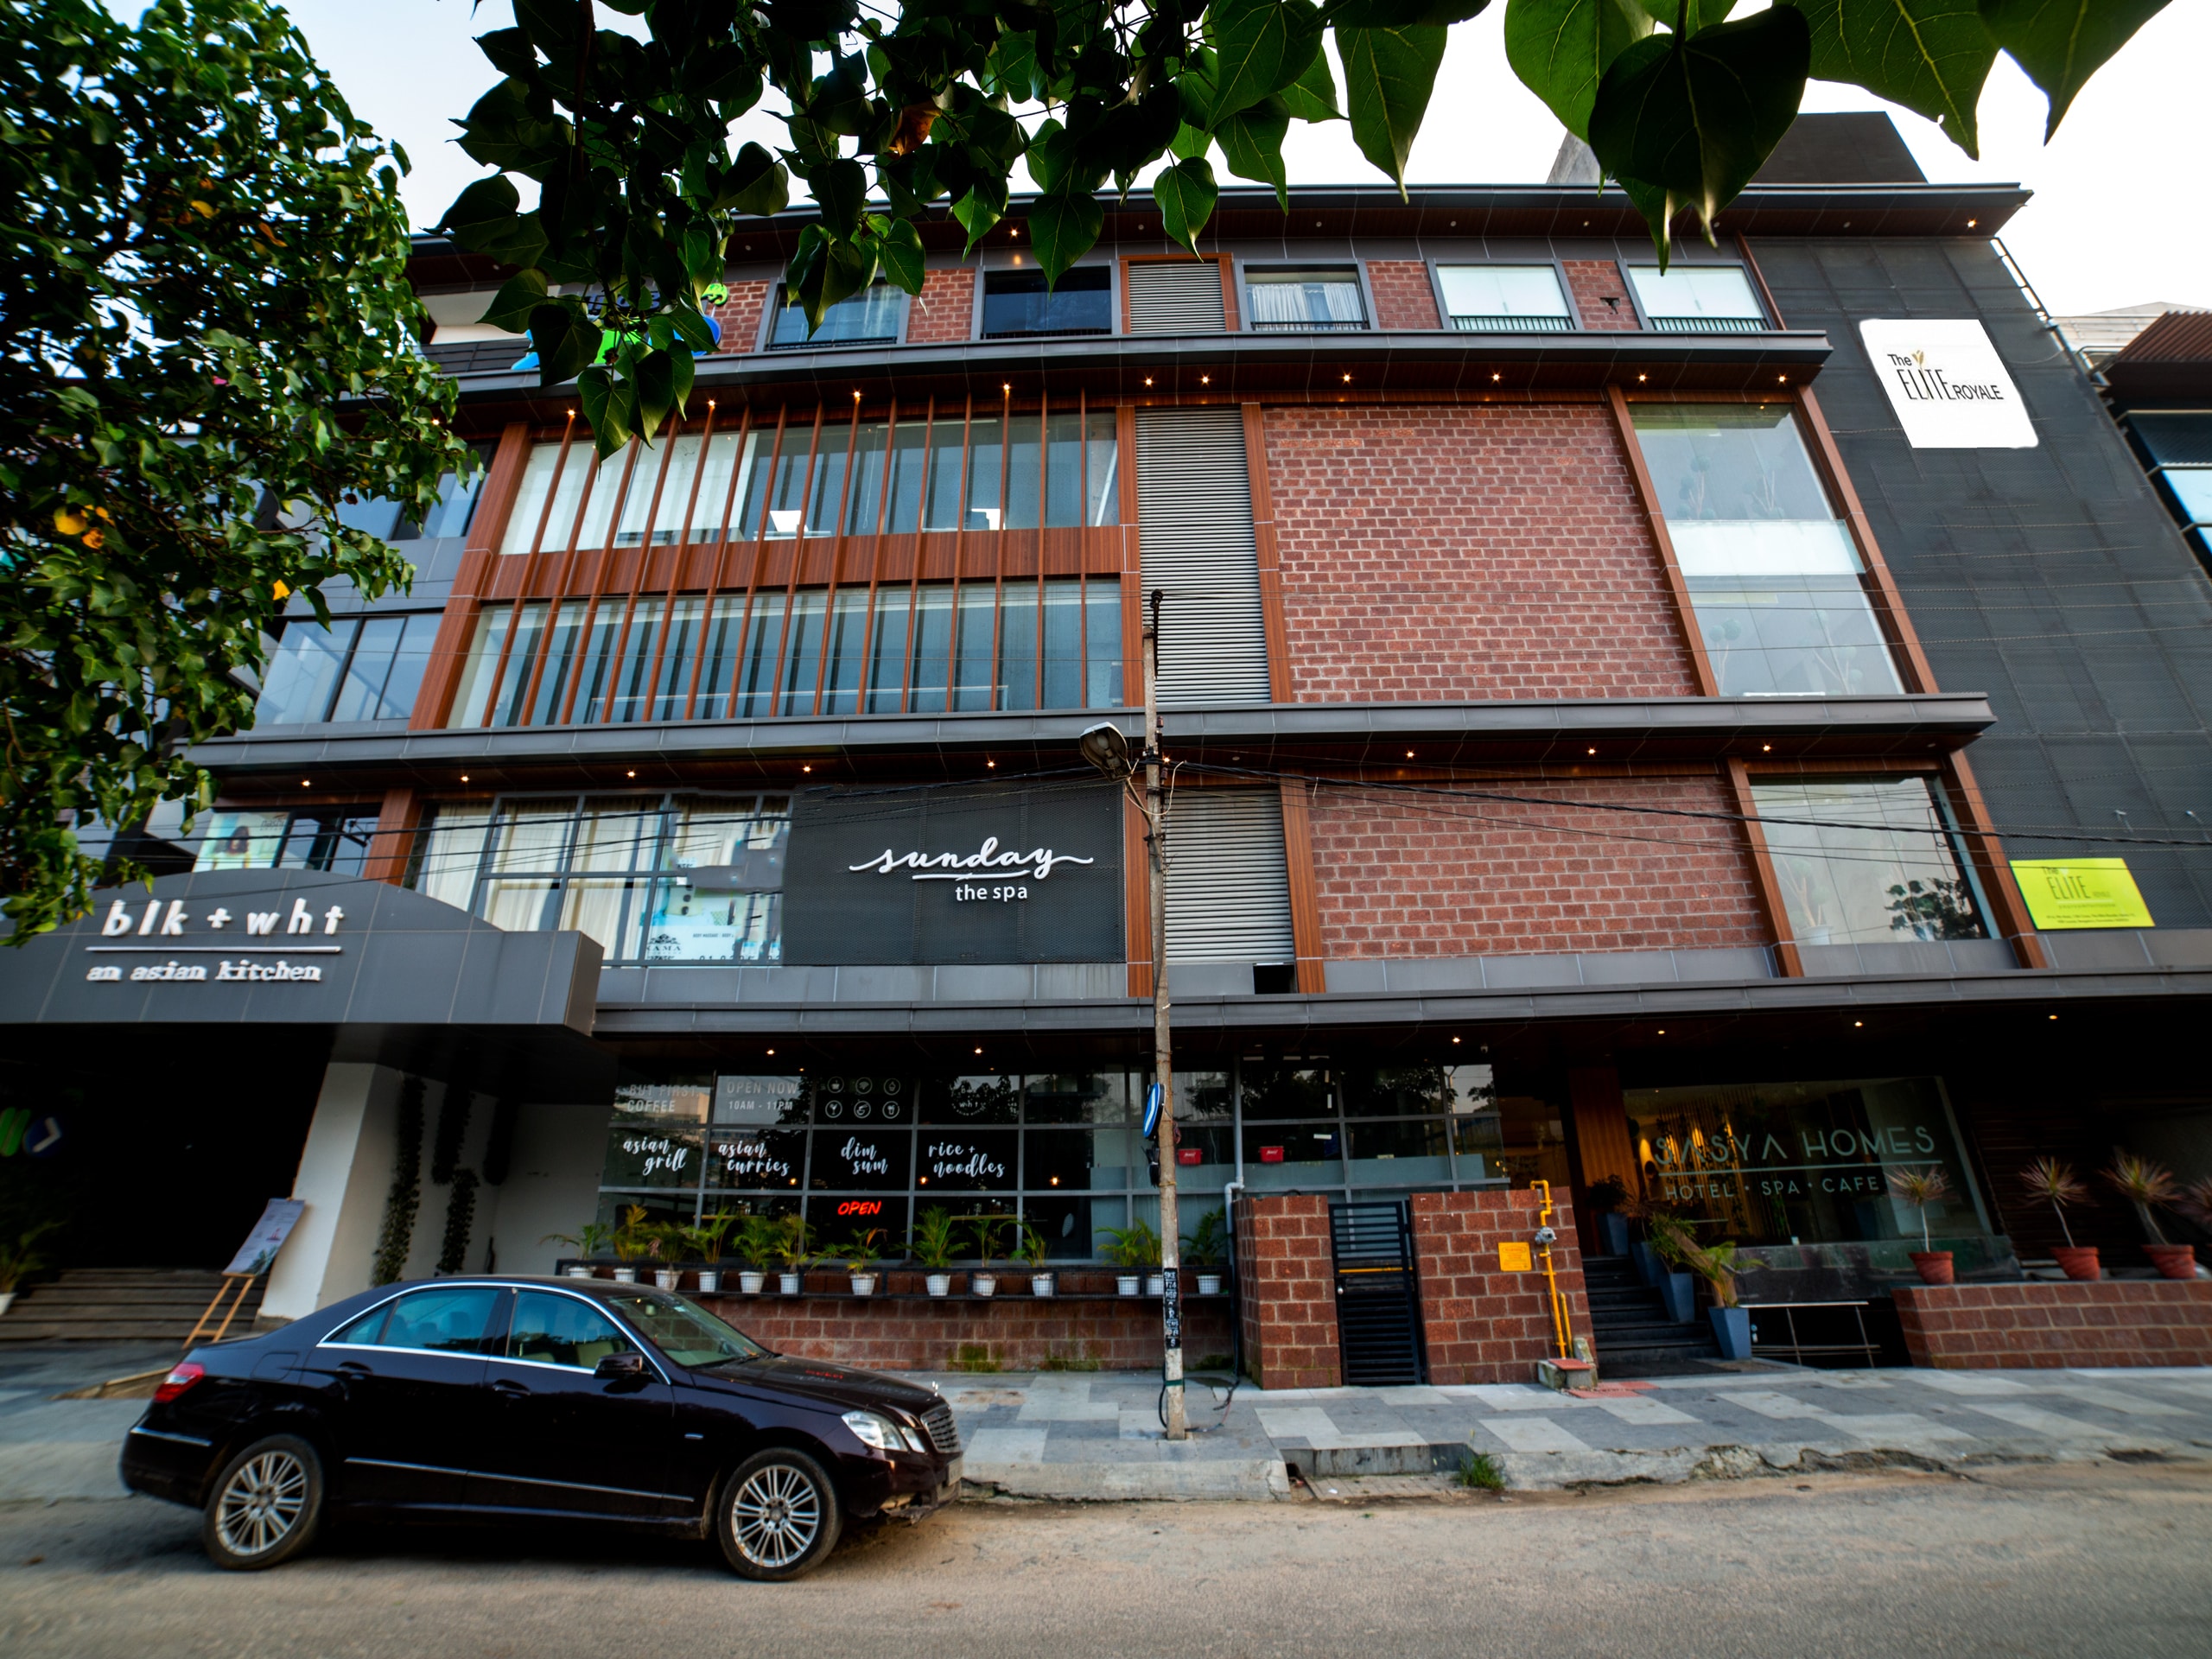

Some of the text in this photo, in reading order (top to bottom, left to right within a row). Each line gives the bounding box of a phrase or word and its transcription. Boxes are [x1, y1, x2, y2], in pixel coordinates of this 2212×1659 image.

[1887, 354, 1912, 366] The
[1897, 369, 2004, 400] ELITE ROYALE
[849, 836, 1093, 880] sunday
[956, 884, 1027, 903] the spa
[2046, 875, 2090, 899] ELITE
[102, 898, 345, 937] blk + wht
[86, 960, 321, 982] an asian kitchen
[629, 1084, 653, 1096] BUT
[727, 1082, 798, 1095] OPEN NOW
[627, 1100, 676, 1112] COFFEE
[728, 1101, 754, 1109] 10AM
[766, 1101, 793, 1110] 11PM
[623, 1136, 671, 1155] asian
[719, 1141, 766, 1158] asian
[840, 1136, 877, 1161] dim
[929, 1142, 964, 1158] rice
[1654, 1126, 1935, 1166] SASYA HOMES
[643, 1147, 687, 1176] grill
[727, 1157, 790, 1177] curries
[852, 1156, 888, 1176] sum
[933, 1154, 1005, 1179] noodles
[1665, 1176, 1878, 1201] HOTEL SPA CAFE
[838, 1201, 882, 1216] OPEN
